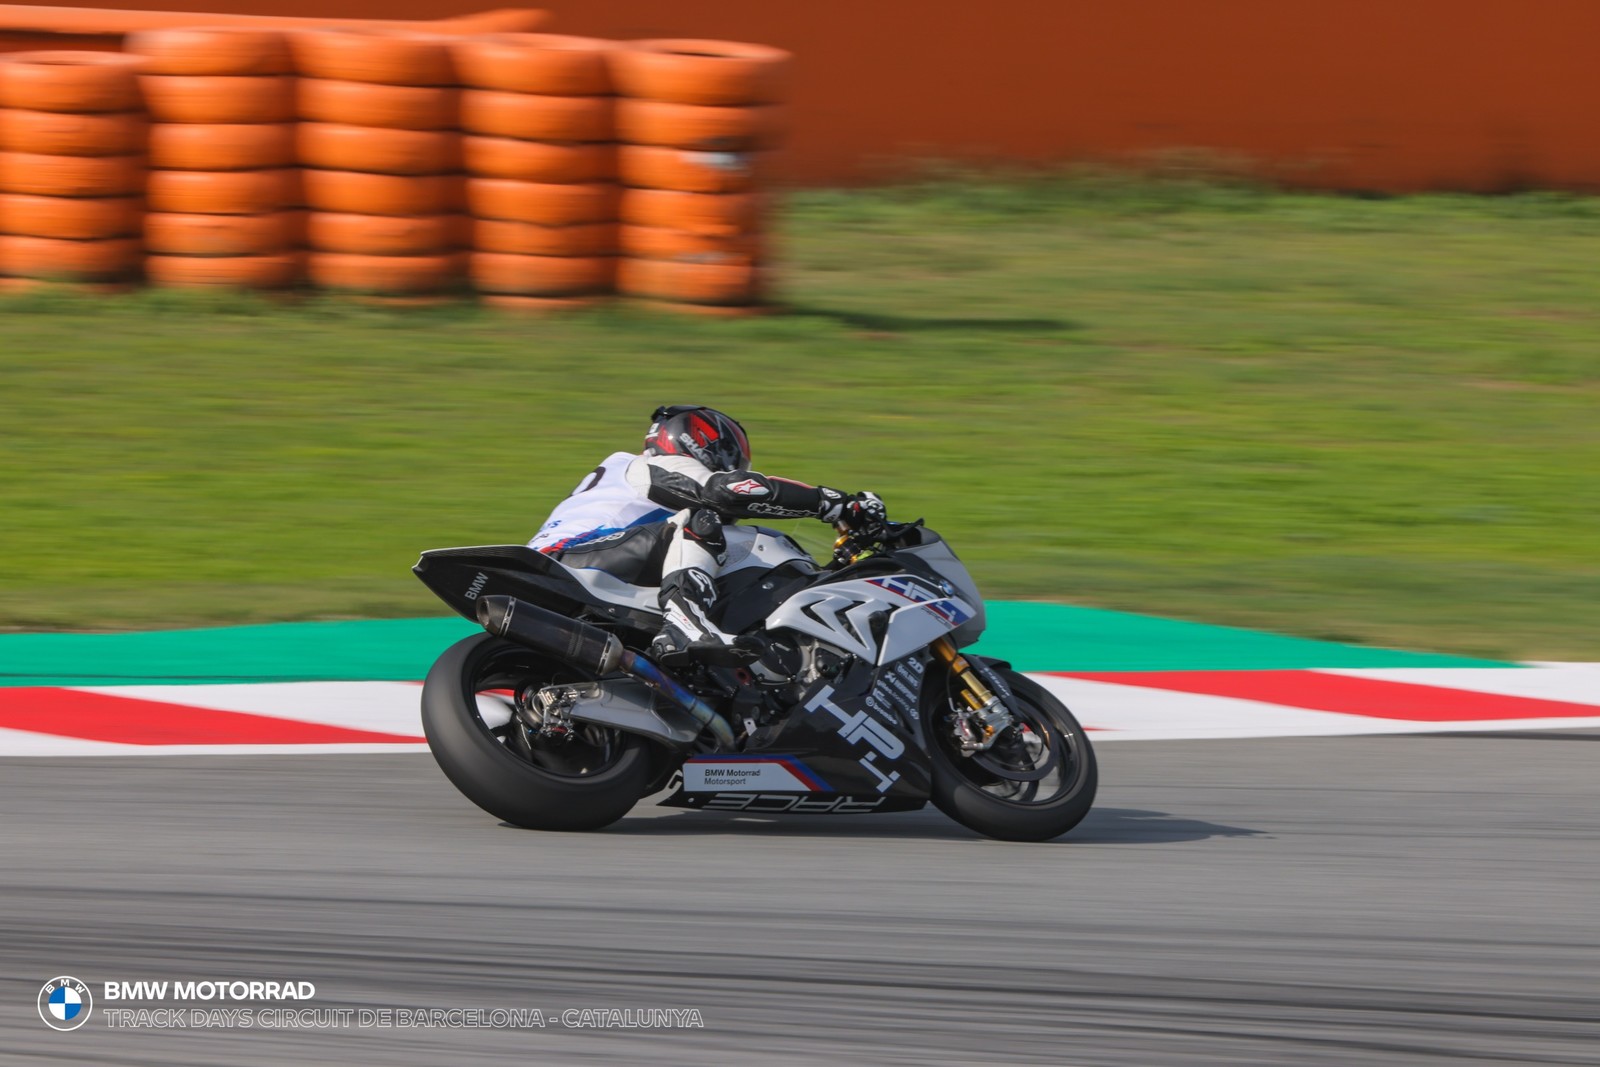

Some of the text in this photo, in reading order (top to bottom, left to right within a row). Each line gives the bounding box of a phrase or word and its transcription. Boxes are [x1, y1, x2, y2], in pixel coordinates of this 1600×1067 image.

[464, 572, 489, 601] BMW
[881, 578, 956, 623] HP4
[803, 684, 905, 794] HP4
[703, 777, 747, 786] Motorsport
[704, 768, 761, 777] BMW Motorrad
[702, 792, 886, 812] RACE
